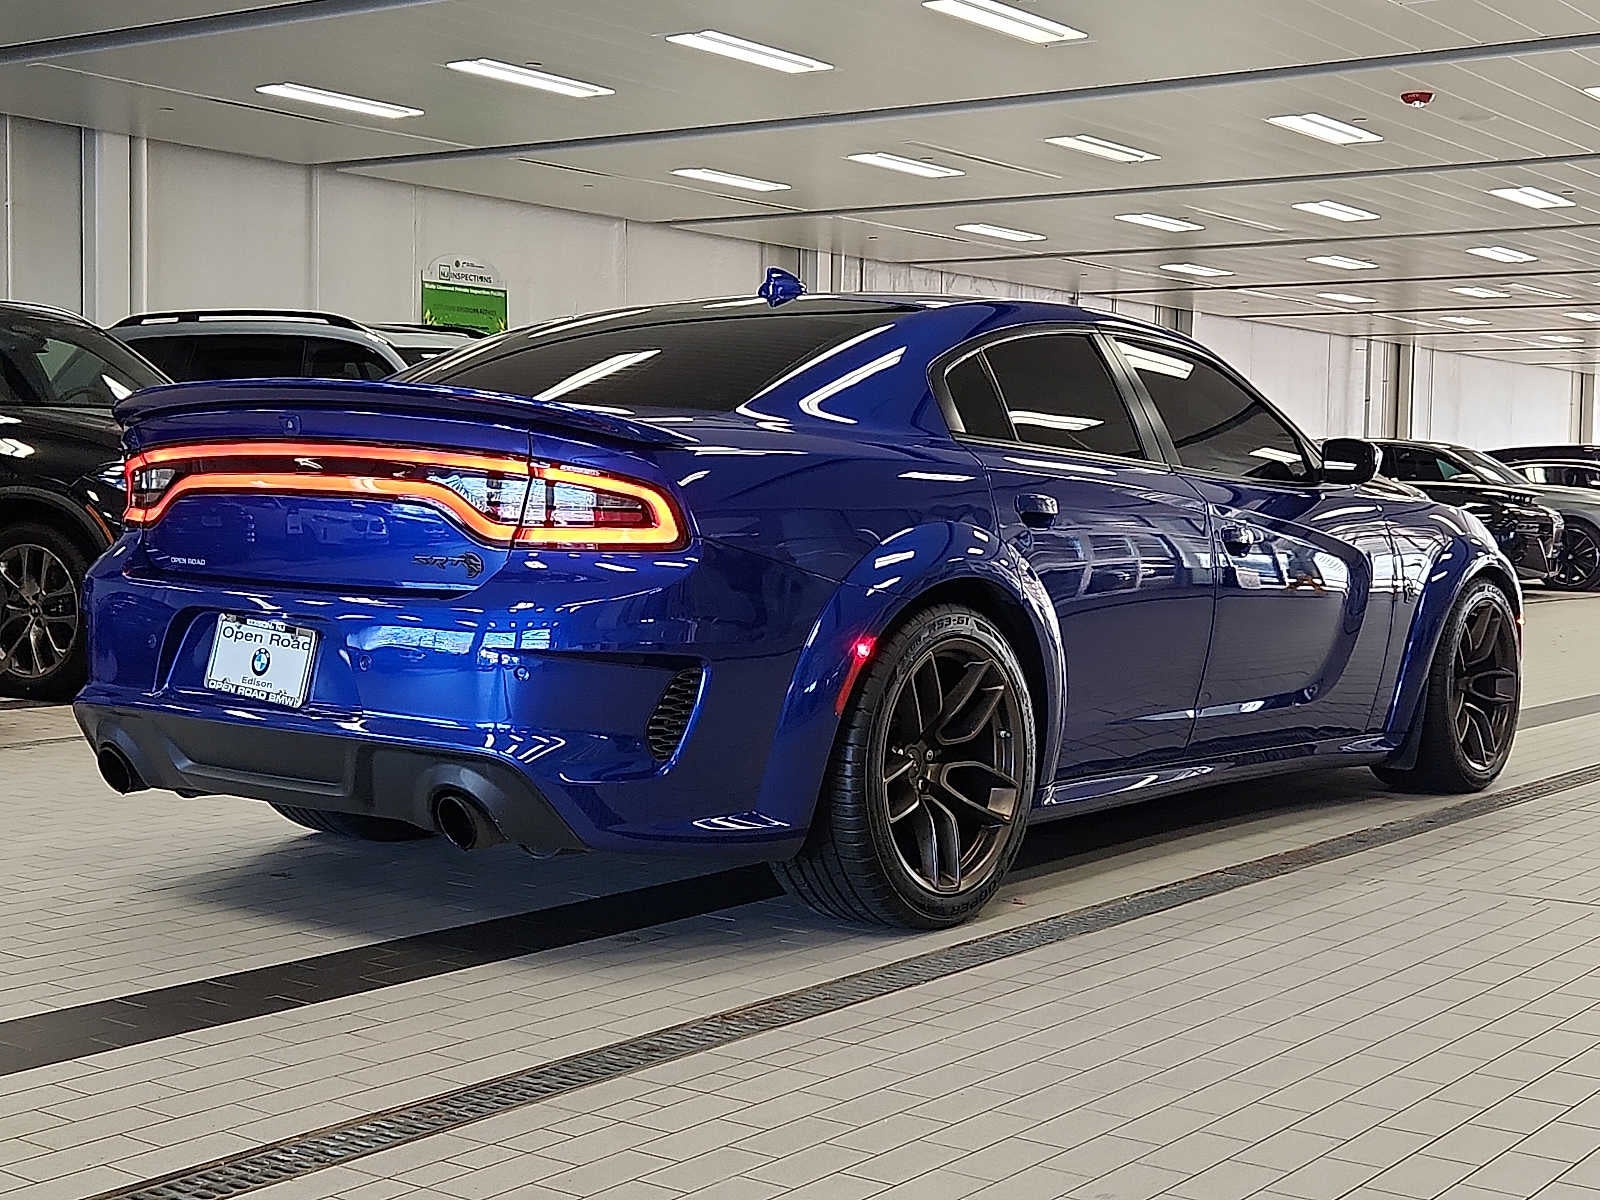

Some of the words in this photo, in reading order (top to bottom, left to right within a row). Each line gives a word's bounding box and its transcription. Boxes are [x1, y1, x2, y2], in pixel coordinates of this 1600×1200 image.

[449, 272, 492, 283] INSPECTIONS
[170, 556, 187, 564] OPEN
[187, 557, 206, 566] ROAD
[222, 626, 264, 643] Open
[269, 633, 312, 651] Road
[241, 676, 273, 689] Edison
[209, 681, 236, 694] OPEN
[237, 687, 267, 701] ROAD
[268, 693, 298, 706] BMW
